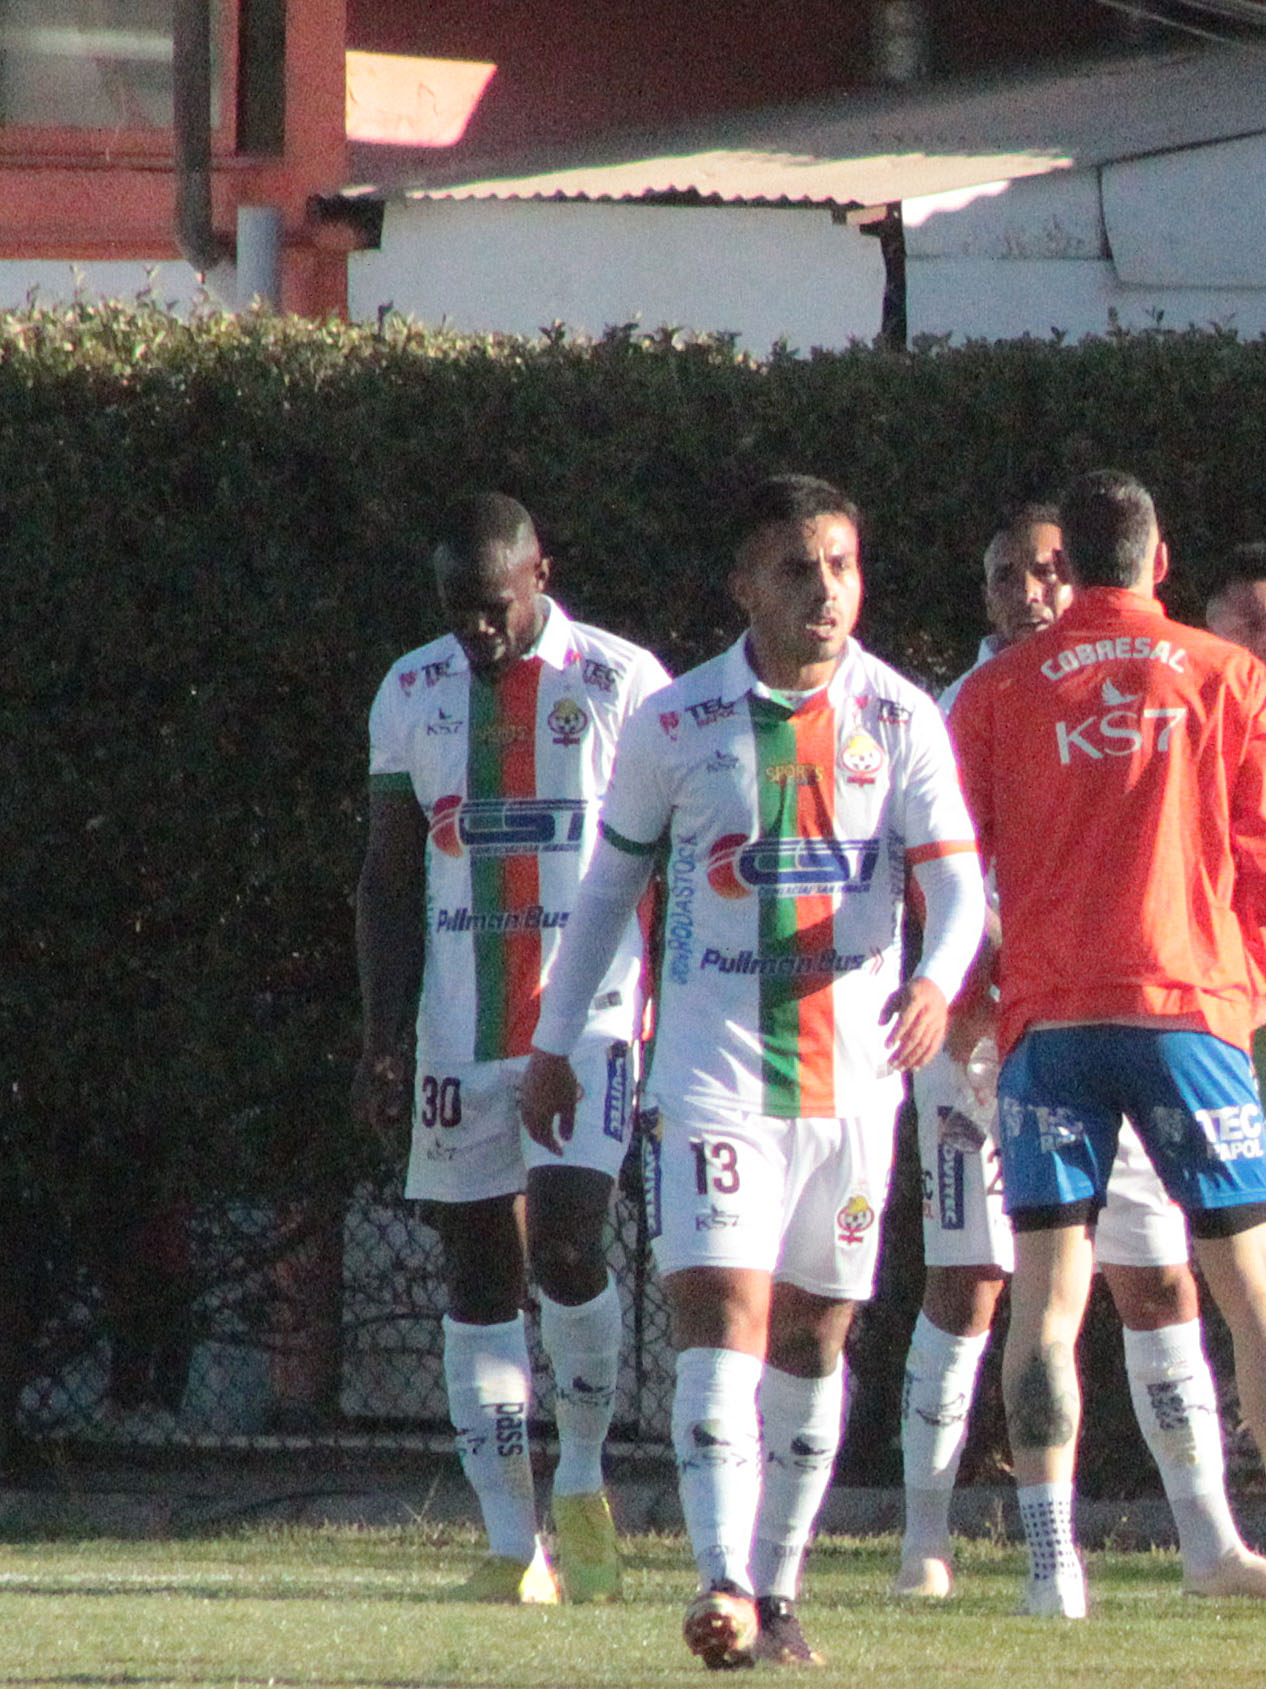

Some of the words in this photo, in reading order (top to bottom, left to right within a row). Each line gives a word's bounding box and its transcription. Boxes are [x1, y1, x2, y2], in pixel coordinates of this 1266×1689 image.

[1040, 637, 1187, 681] COBRESAL
[1055, 707, 1188, 765] KS7
[701, 948, 811, 975] Pullman
[818, 949, 866, 972] Bus
[421, 1075, 462, 1128] 30
[1195, 1103, 1262, 1143] TEC
[689, 1142, 740, 1196] 13
